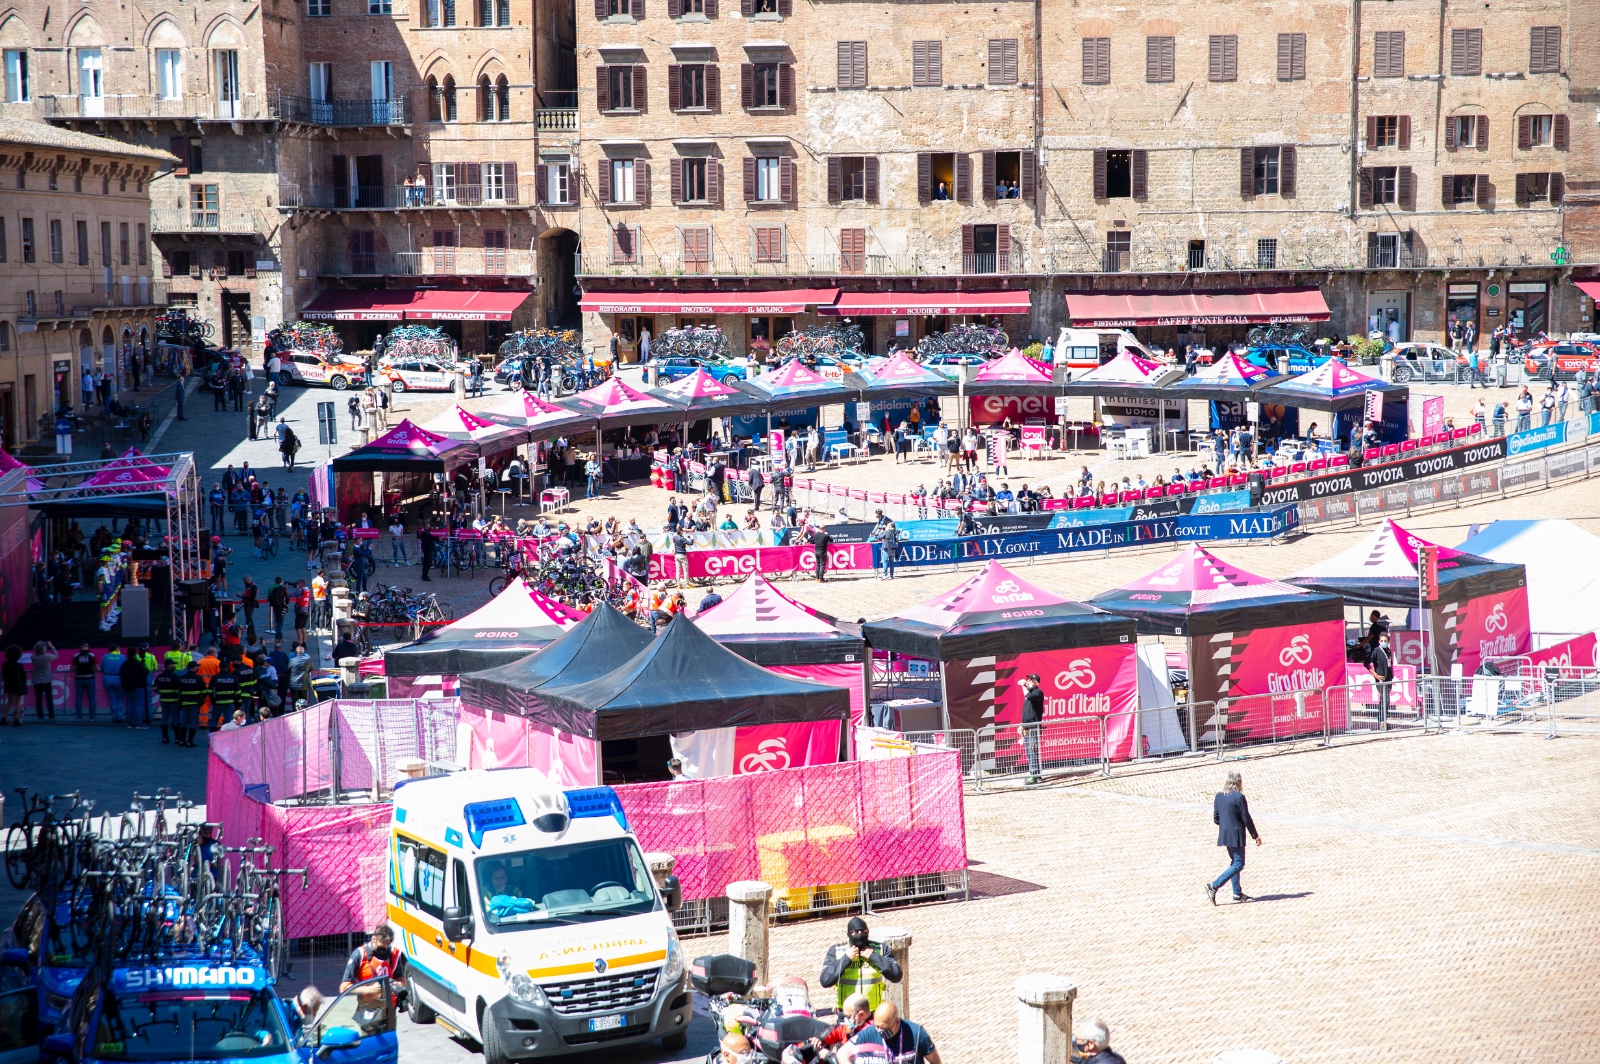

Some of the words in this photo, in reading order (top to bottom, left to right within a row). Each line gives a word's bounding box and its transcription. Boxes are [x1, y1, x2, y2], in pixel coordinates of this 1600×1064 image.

[361, 312, 398, 320] PIZZERIA
[431, 312, 485, 320] SPADAFORTE
[1157, 317, 1190, 326] CAFFE'
[1197, 316, 1224, 325] FONTE
[1225, 315, 1249, 324] GAIA
[1269, 315, 1309, 323] GELATERIA
[291, 368, 326, 379] Cofidis
[984, 396, 1049, 413] enel
[1125, 408, 1156, 417] UOMO
[1023, 430, 1042, 440] enel
[1510, 430, 1556, 453] mediolanum
[1463, 443, 1502, 464] TOYOTA
[1414, 455, 1454, 475] TOYOTA
[1363, 466, 1404, 486] TOYOTA
[1309, 476, 1352, 496] TOYOTA
[1262, 487, 1299, 505] OYOTA
[1198, 502, 1220, 513] eolo
[1057, 529, 1113, 549] MADE
[1113, 533, 1124, 544] IN
[704, 549, 763, 575] enel
[939, 549, 951, 560] IN
[648, 555, 667, 579] el
[1000, 609, 1044, 619] #GIRO
[473, 630, 519, 639] #GIRO
[1267, 672, 1290, 693] Giro
[1291, 667, 1325, 688] d'Italia
[1041, 696, 1066, 717] Giro
[1068, 692, 1110, 714] d'Italia
[126, 967, 255, 988] SHIMANO
